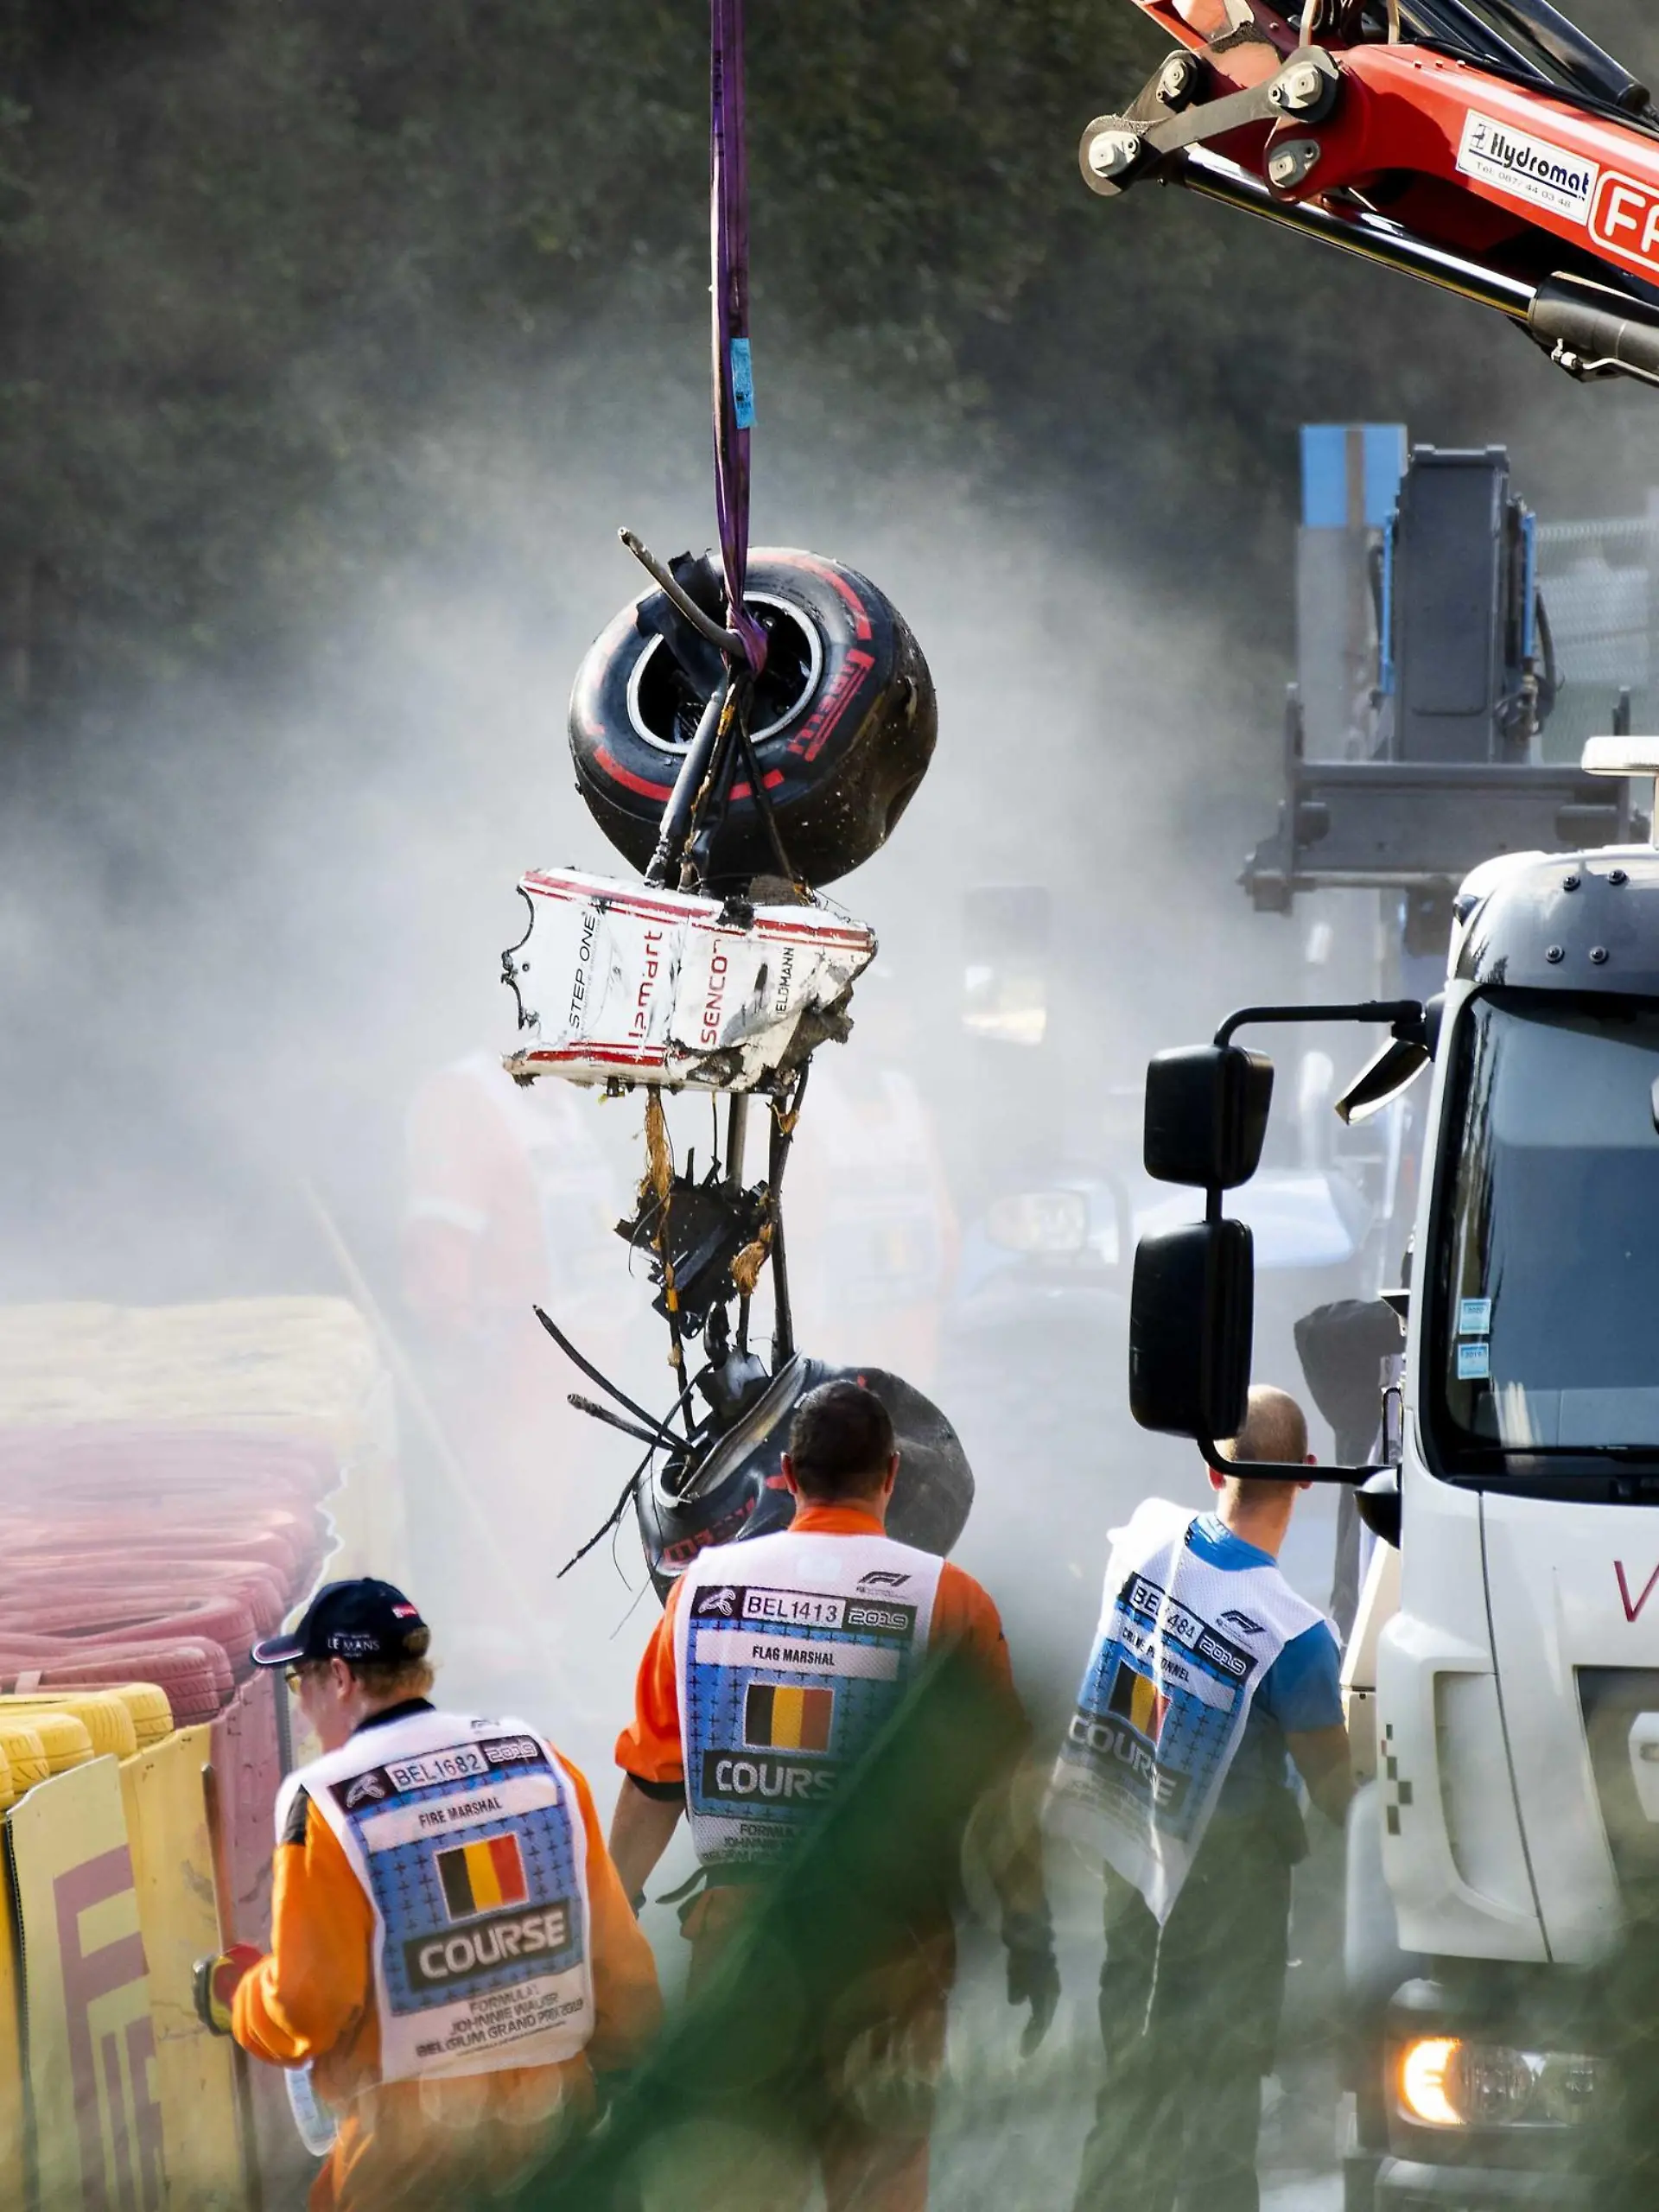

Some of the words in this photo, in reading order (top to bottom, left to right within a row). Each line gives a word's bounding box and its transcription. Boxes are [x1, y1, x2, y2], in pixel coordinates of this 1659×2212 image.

[1491, 132, 1590, 194] Hydromat
[569, 968, 586, 1029] STEP
[579, 914, 596, 962] ONE
[747, 1596, 837, 1623] BEL1413
[847, 1607, 908, 1630] 2019
[327, 1637, 339, 1650] LE
[343, 1641, 380, 1651] MANS
[753, 1645, 781, 1660] FLAG
[783, 1649, 836, 1666] MARSHAL
[1198, 1636, 1247, 1676] 2019
[391, 1753, 482, 1788] BEL1682
[485, 1741, 540, 1764] 2019
[715, 1759, 838, 1800] COURS
[1069, 1714, 1178, 1807] COURE
[418, 1811, 448, 1828] FIRE
[448, 1797, 503, 1821] MARSHAL
[419, 1909, 566, 1980] COURSE
[450, 2005, 512, 2037] JOHNNIE
[487, 2014, 537, 2039] GRAND
